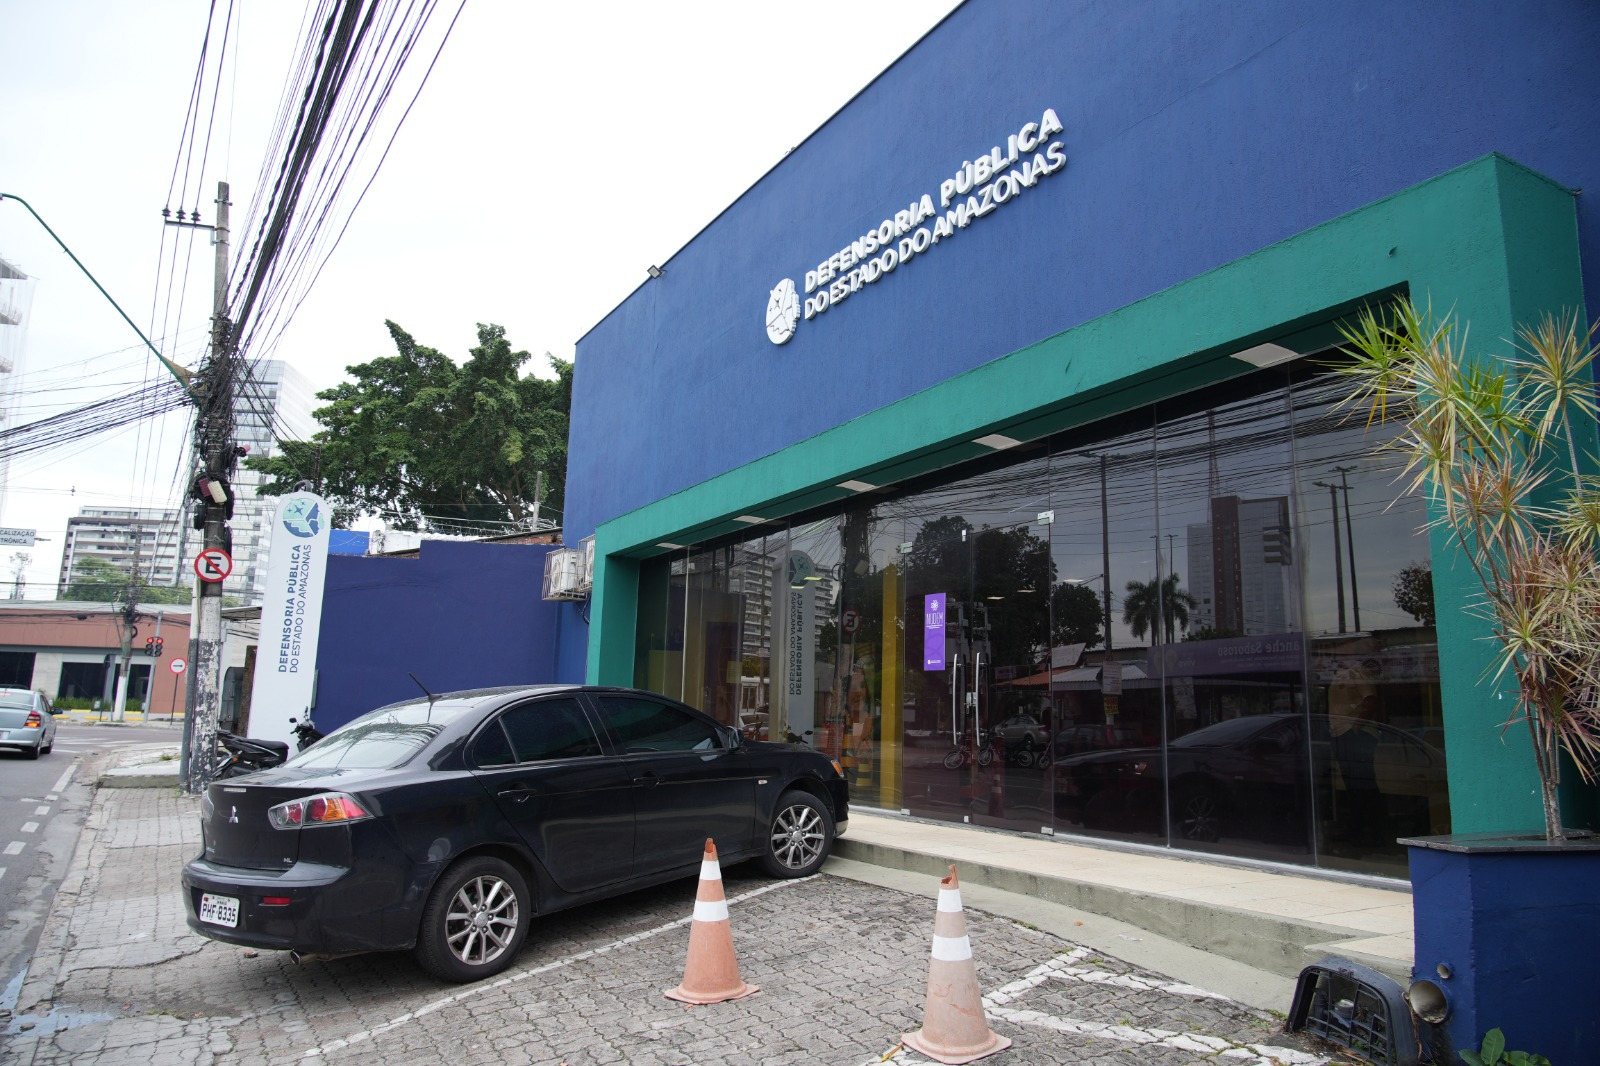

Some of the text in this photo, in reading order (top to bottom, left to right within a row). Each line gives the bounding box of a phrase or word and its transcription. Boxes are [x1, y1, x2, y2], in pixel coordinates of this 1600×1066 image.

[804, 141, 1067, 320] DO ESTADO DO AMAZONAS
[805, 108, 1064, 293] DEFENSORIA PÚBLICA
[205, 556, 222, 575] E
[278, 544, 301, 673] DEFENSORIA PÚBLICA
[289, 544, 312, 673] DO ESTADO DO AMAZONAS
